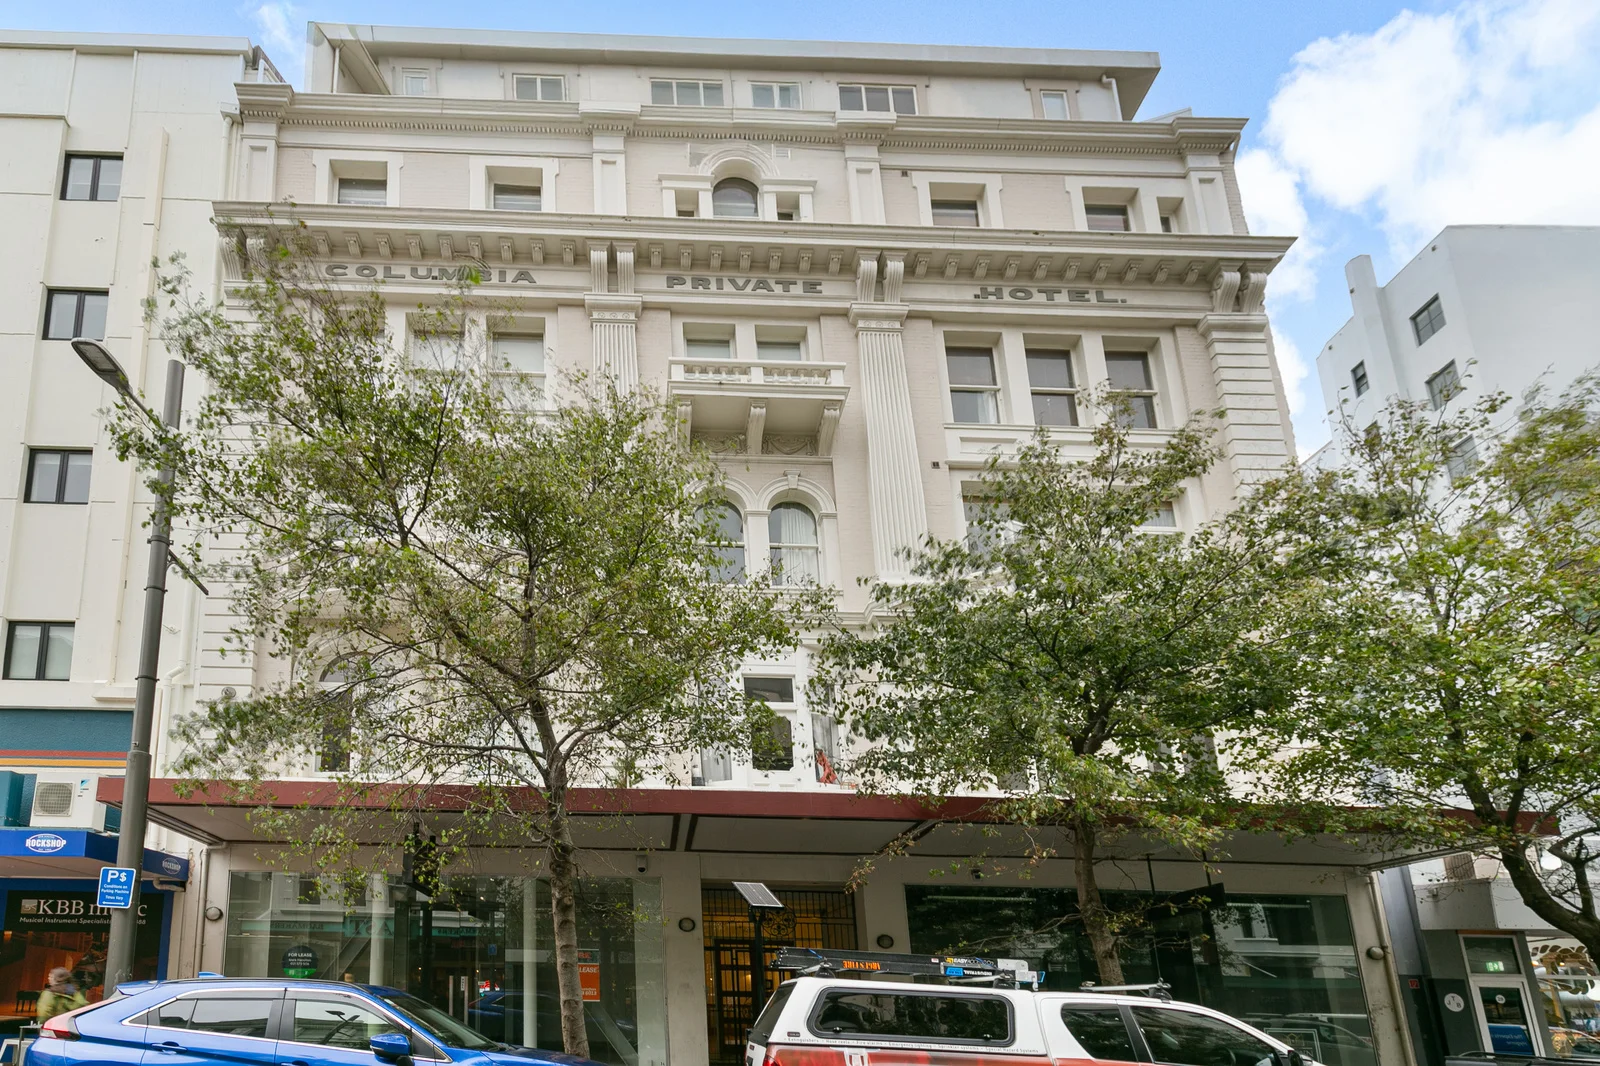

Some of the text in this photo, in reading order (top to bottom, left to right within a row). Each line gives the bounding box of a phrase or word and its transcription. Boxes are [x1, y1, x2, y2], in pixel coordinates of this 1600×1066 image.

[666, 276, 823, 294] PRIVATE
[25, 839, 67, 847] ROCKSHOP
[37, 899, 84, 915] KBB
